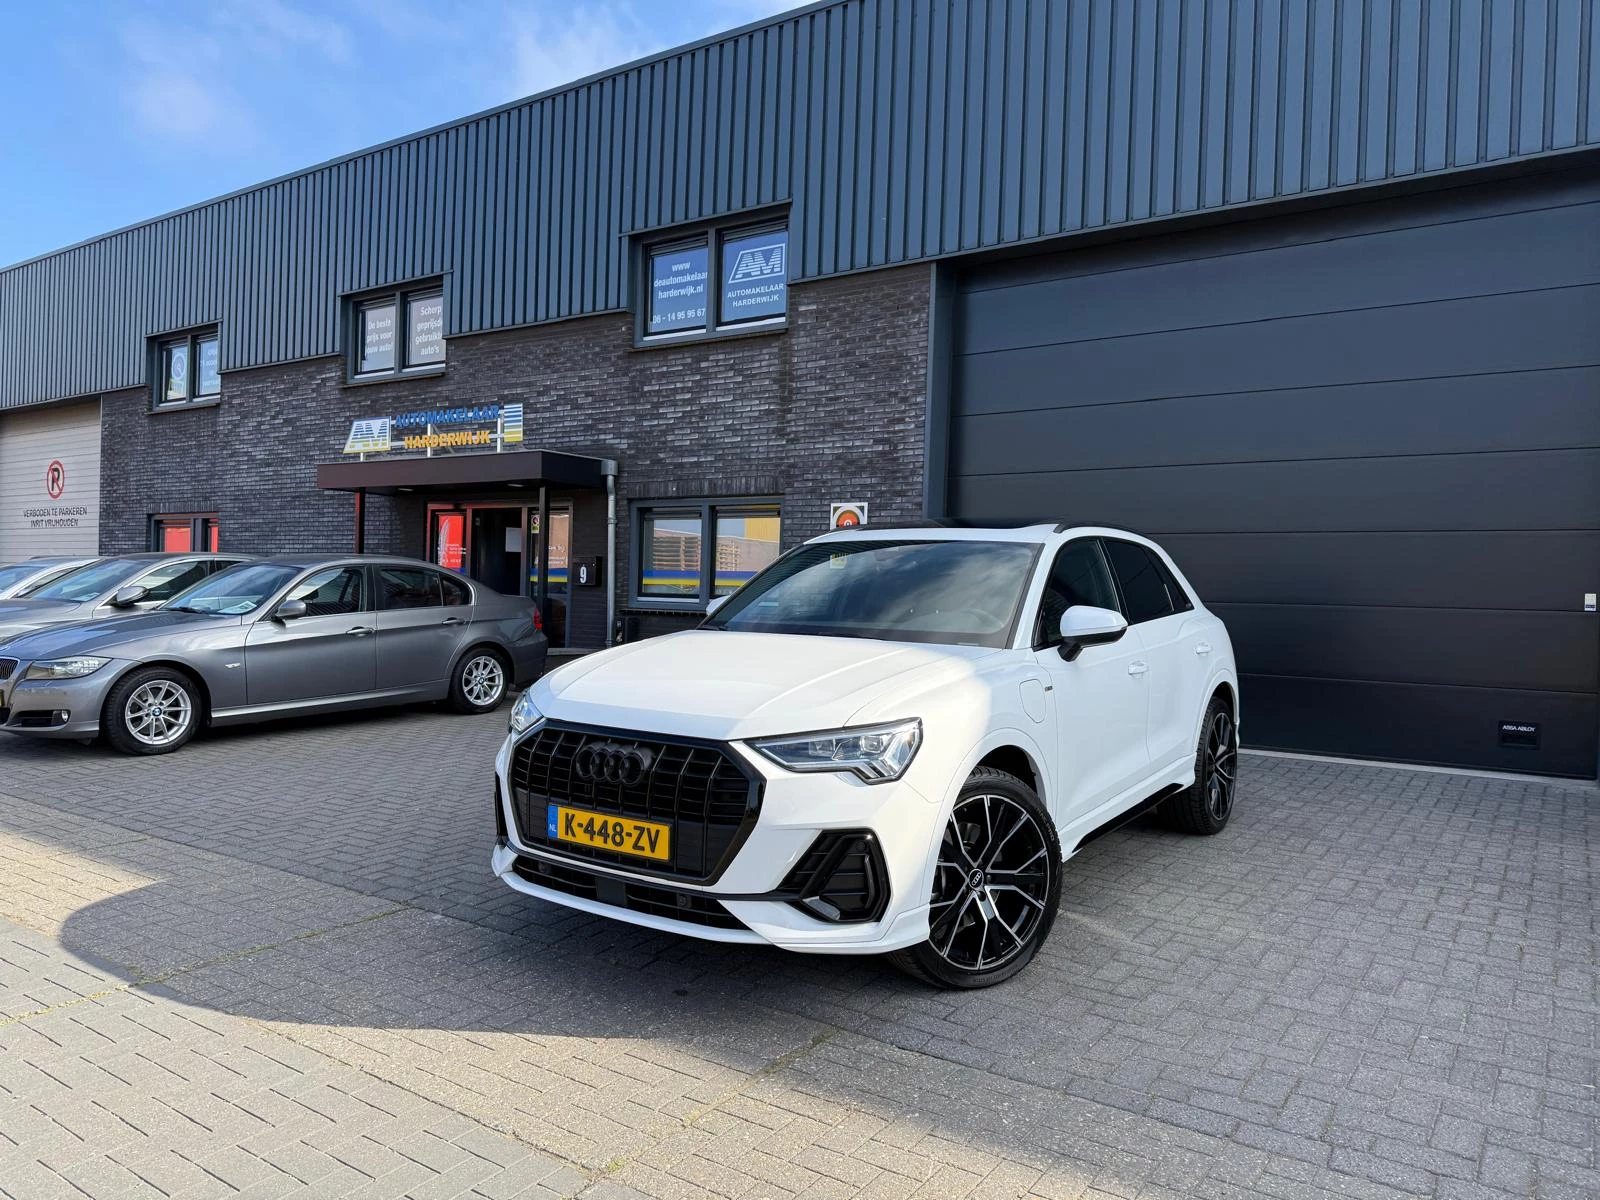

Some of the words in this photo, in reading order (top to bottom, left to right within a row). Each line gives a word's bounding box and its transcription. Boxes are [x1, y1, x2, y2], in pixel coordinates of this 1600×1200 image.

[727, 283, 784, 298] AUTOMAKELAAR
[732, 294, 780, 308] HARDERWIJK
[667, 312, 676, 322] 14
[686, 309, 696, 319] 95
[394, 405, 500, 429] AUTOMAKELAAR
[404, 430, 491, 449] HARDERWIJK
[51, 508, 58, 516] TE
[59, 506, 88, 516] PARKEREN
[579, 566, 587, 584] 9
[550, 824, 557, 832] NL
[564, 812, 661, 854] K-448-ZV
